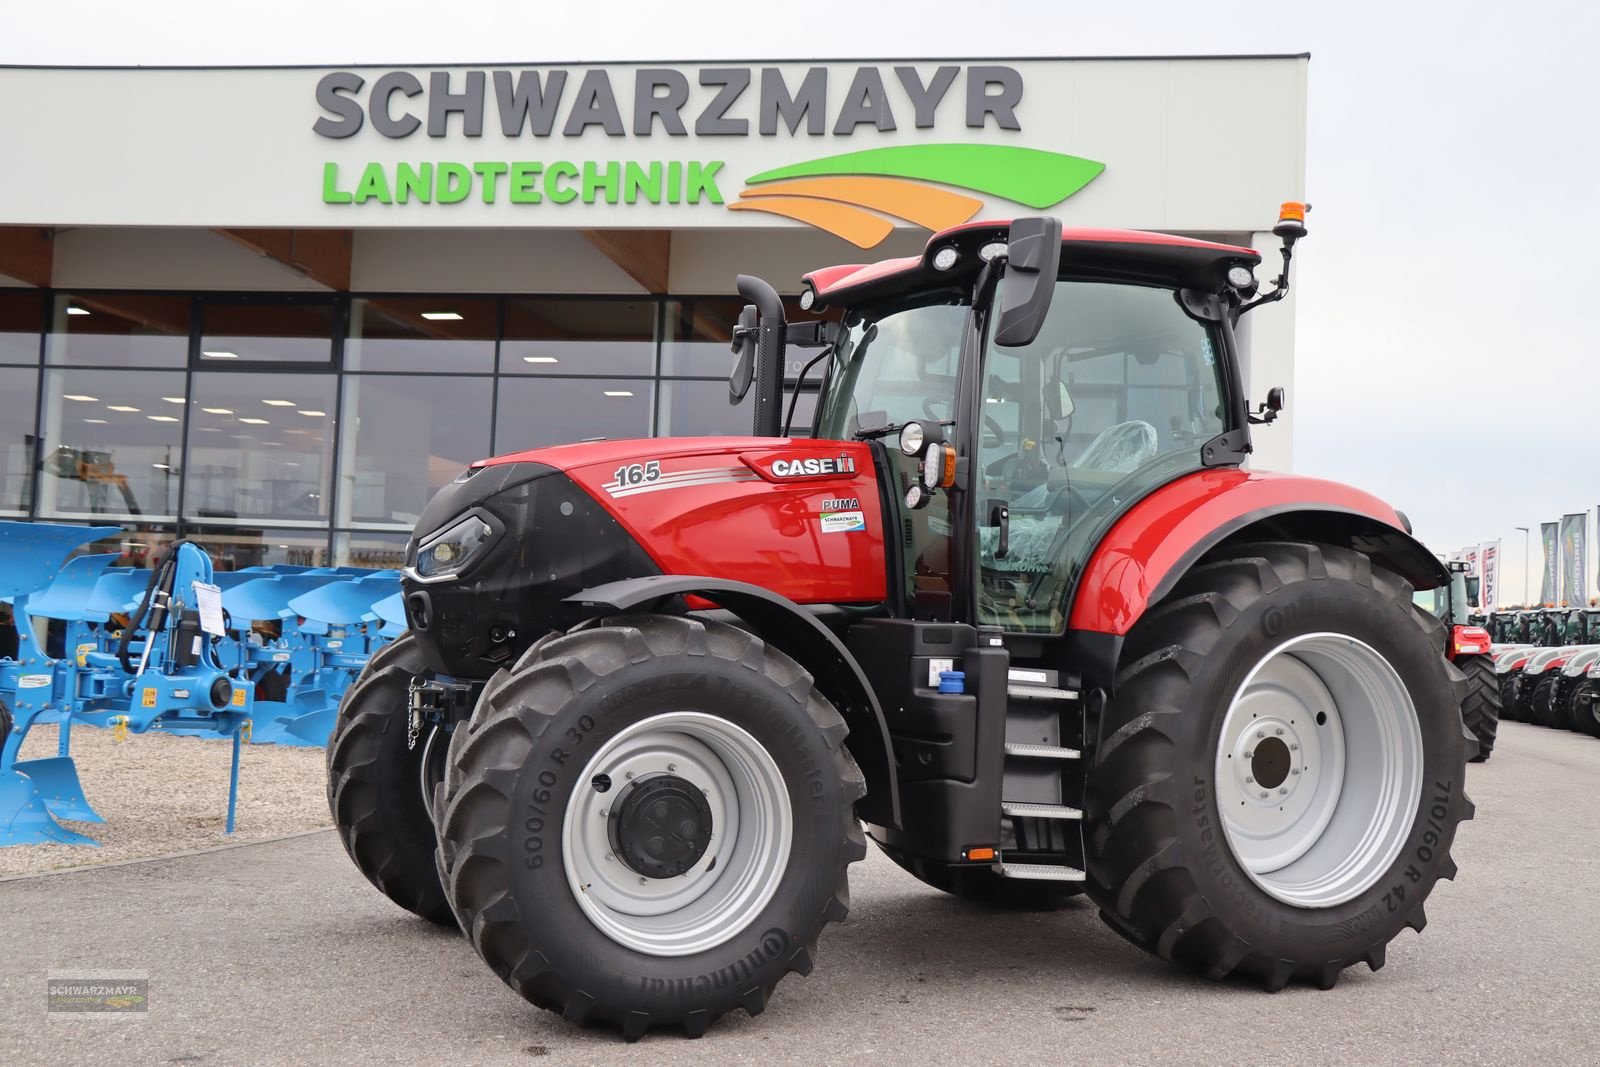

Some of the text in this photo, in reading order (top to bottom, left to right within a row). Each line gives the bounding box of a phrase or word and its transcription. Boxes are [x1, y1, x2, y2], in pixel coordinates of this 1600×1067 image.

[312, 66, 1023, 139] SCHWARZMAYR
[322, 161, 725, 204] LANDTECHNIK
[615, 461, 660, 488] 165
[771, 458, 834, 477] CASE
[822, 498, 859, 511] PUMA
[524, 714, 596, 870] 600/60 R 30
[1382, 780, 1452, 912] 710/60 R 42
[640, 927, 790, 997] Continental
